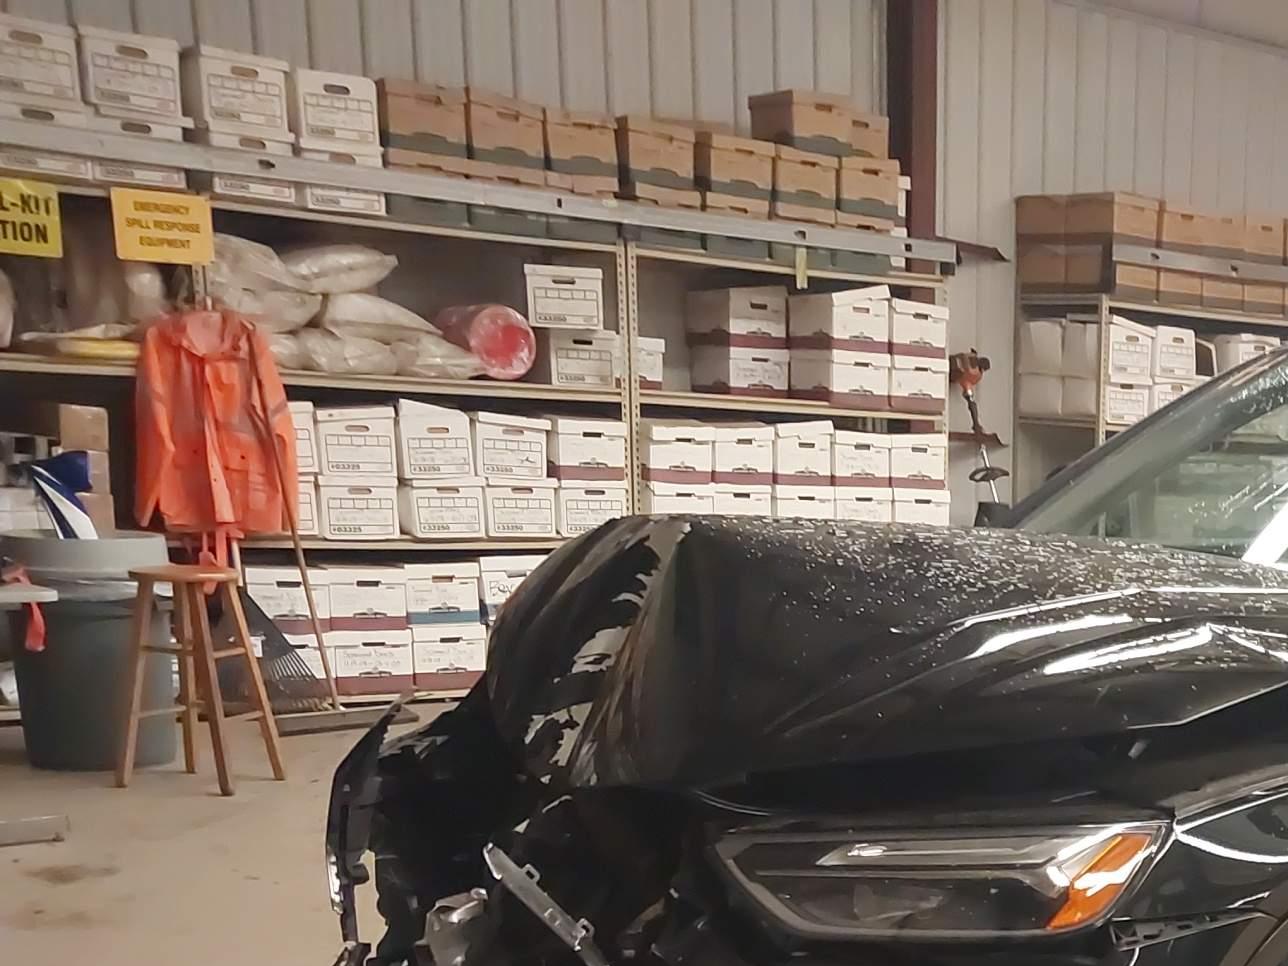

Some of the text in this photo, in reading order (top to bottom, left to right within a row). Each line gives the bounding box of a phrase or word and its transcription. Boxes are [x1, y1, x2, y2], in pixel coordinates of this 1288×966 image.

[133, 201, 190, 215] EMERGENCY
[126, 217, 201, 234] SPILL RESPONSE
[139, 235, 191, 249] EQUIPMENT
